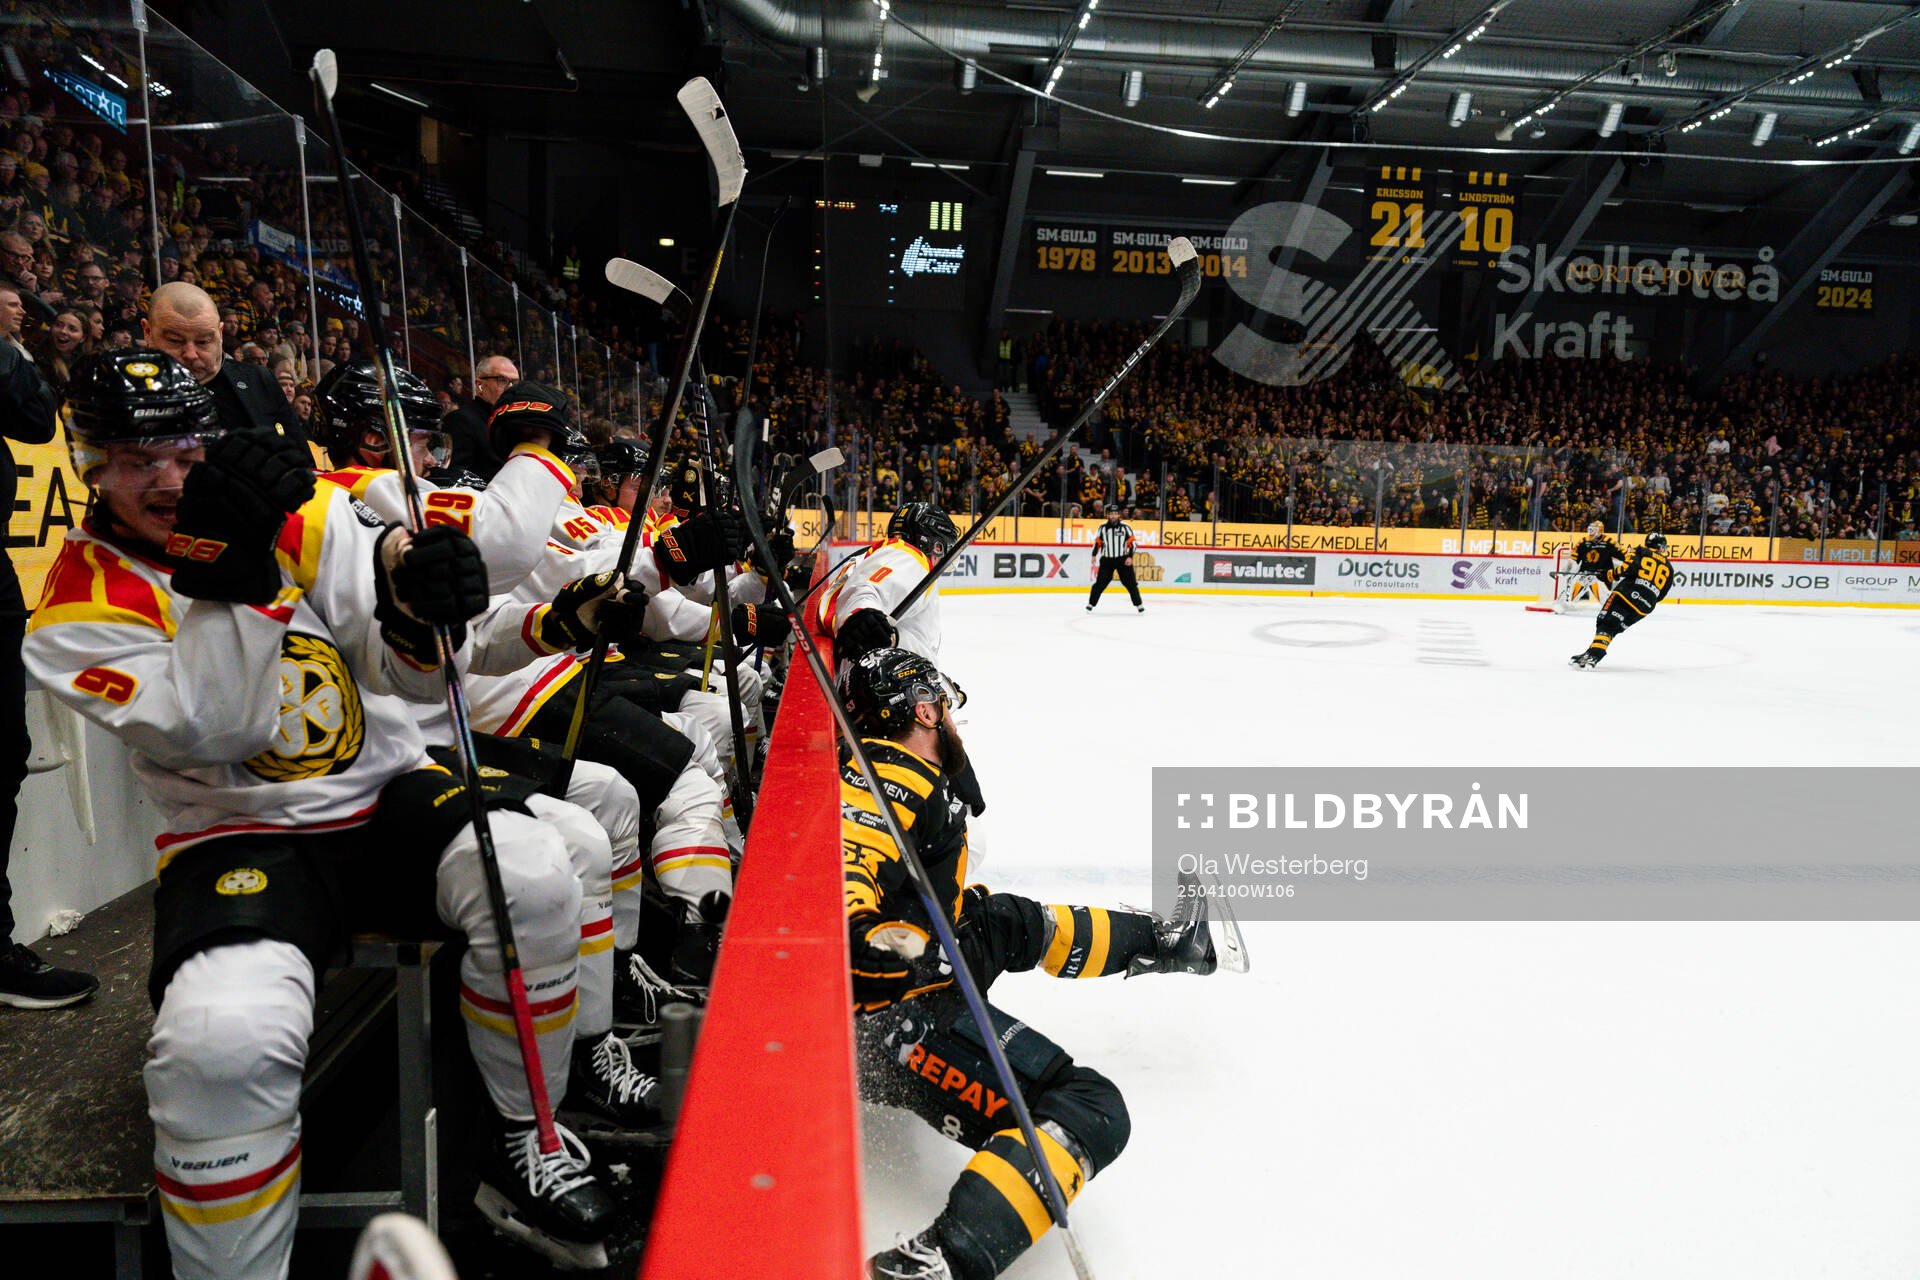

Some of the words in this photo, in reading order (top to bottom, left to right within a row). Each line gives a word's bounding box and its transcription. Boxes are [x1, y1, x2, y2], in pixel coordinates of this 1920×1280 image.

[1376, 187, 1424, 199] ERICSSON
[1459, 192, 1515, 205] LINDSTRÖM
[1370, 201, 1425, 248] 21
[1458, 206, 1514, 252] 10
[1037, 246, 1096, 271] 1978
[1112, 250, 1171, 275] 2013
[1497, 243, 1779, 303] Skellefteå
[1566, 262, 1655, 285] NORTH
[1660, 269, 1746, 290] POWER
[1816, 286, 1873, 309] 2024
[1493, 311, 1634, 361] Kraft
[134, 407, 185, 418] BAUER
[563, 516, 599, 543] 45
[994, 553, 1069, 578] BDX
[1234, 561, 1306, 579] valutec
[1495, 566, 1541, 576] Skellefteå
[1638, 556, 1671, 590] 96
[1354, 579, 1362, 587] IT
[1365, 579, 1420, 589] Consultants
[1495, 576, 1518, 585] Kraft
[1690, 572, 1774, 588] HULTDINS
[1781, 575, 1830, 589] JOB
[1845, 576, 1898, 586] GROUP
[897, 668, 918, 679] CCM
[905, 1043, 1009, 1119] REPAY
[181, 1152, 250, 1172] BAUER
